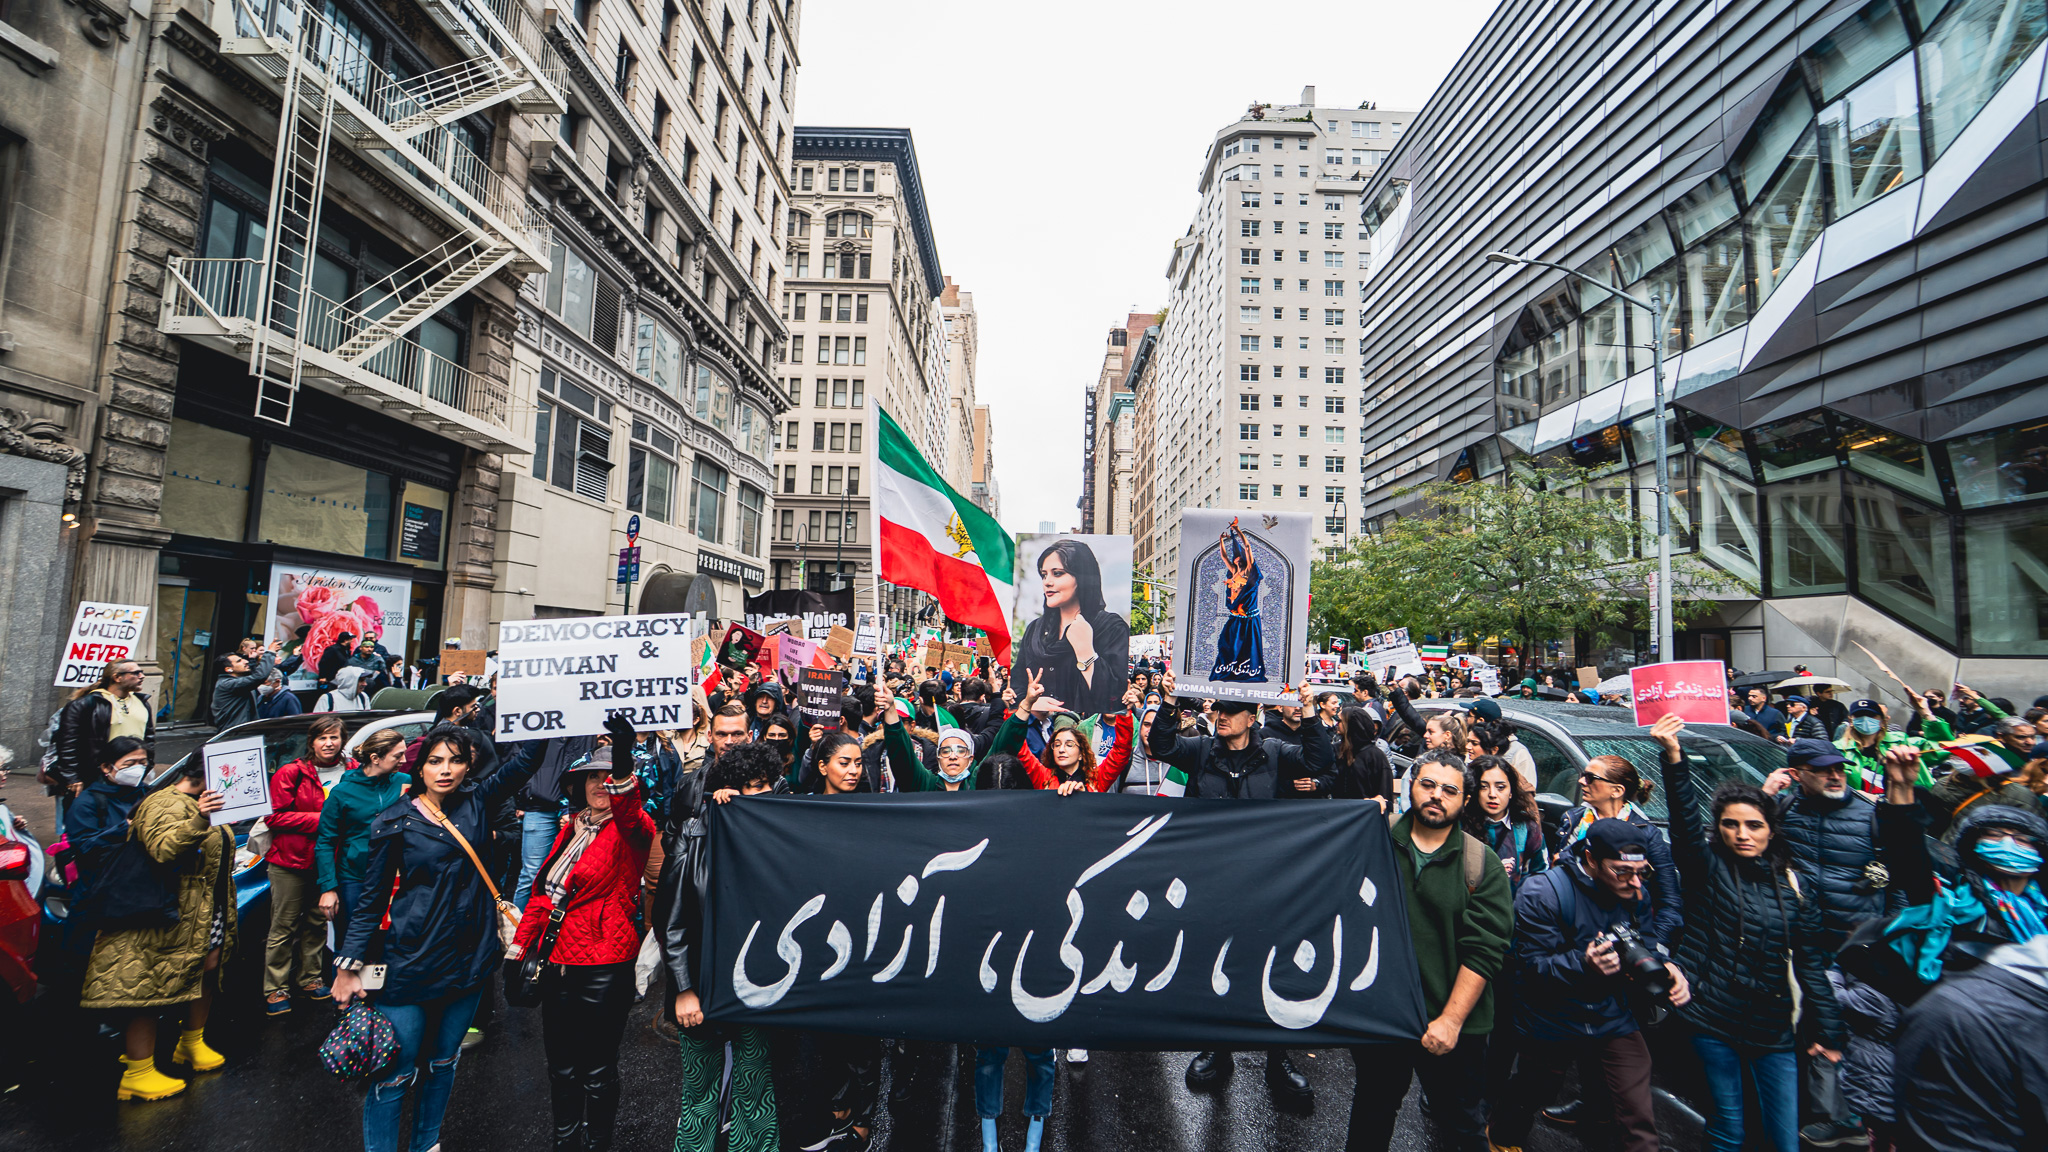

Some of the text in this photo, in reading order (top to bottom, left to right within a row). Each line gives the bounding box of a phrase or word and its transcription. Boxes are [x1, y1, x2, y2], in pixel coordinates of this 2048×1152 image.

[295, 569, 393, 594] Ariston Flowers
[744, 567, 763, 583] HOUSE
[373, 615, 405, 627] Fall 2022
[802, 611, 847, 629] Voice
[78, 621, 137, 640] UNITED
[500, 617, 688, 644] DEMOCRACY
[638, 640, 659, 659] &
[787, 637, 806, 648] WOMAN
[789, 648, 798, 656] LIFE
[69, 642, 129, 663] NEVER
[784, 653, 803, 665] FREEDOM
[500, 654, 619, 679] HUMAN
[807, 671, 832, 681] IRAN
[579, 676, 689, 701] RIGHTS
[801, 683, 838, 694] WOMAN
[1174, 683, 1299, 702] WOMAN, LIFE, FREEDOM
[1636, 680, 1722, 701] زن زندگی آزادی
[807, 696, 829, 705] LIFE
[798, 705, 840, 718] FREEDOM
[500, 710, 566, 734] FOR
[733, 837, 990, 1010] آزادی
